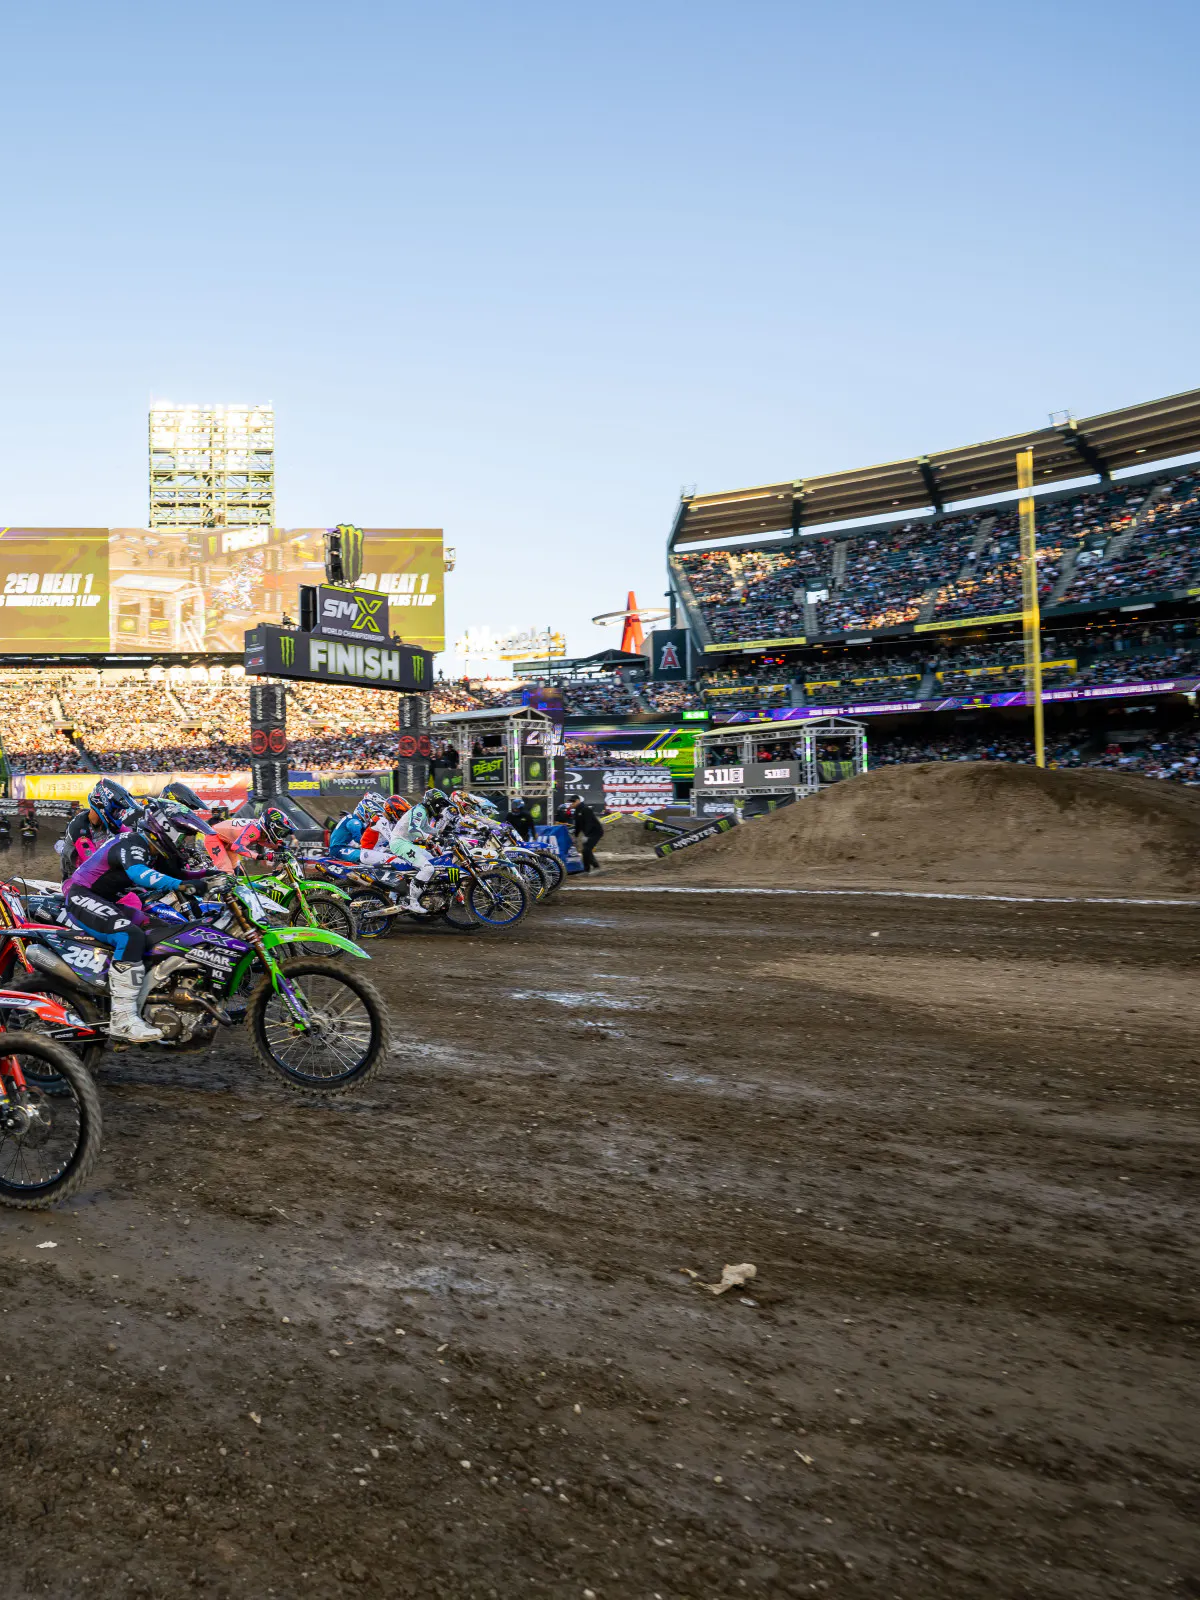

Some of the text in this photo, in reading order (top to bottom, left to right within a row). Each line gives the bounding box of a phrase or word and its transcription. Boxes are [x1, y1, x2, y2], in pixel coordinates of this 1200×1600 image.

[3, 573, 94, 594] 250 HEAT 1
[378, 573, 419, 594] HEAT
[420, 573, 430, 593] 1
[322, 596, 383, 633] SMX
[322, 626, 385, 642] WORLD CHAMPIONSHIP
[309, 638, 400, 681] FINISH
[472, 759, 503, 776] BEAST
[703, 769, 729, 785] 5.11
[332, 777, 377, 785] MONSTER
[672, 826, 719, 849] MONSTER
[327, 864, 343, 875] 43
[61, 945, 108, 974] 284
[188, 948, 230, 966] ADMAR
